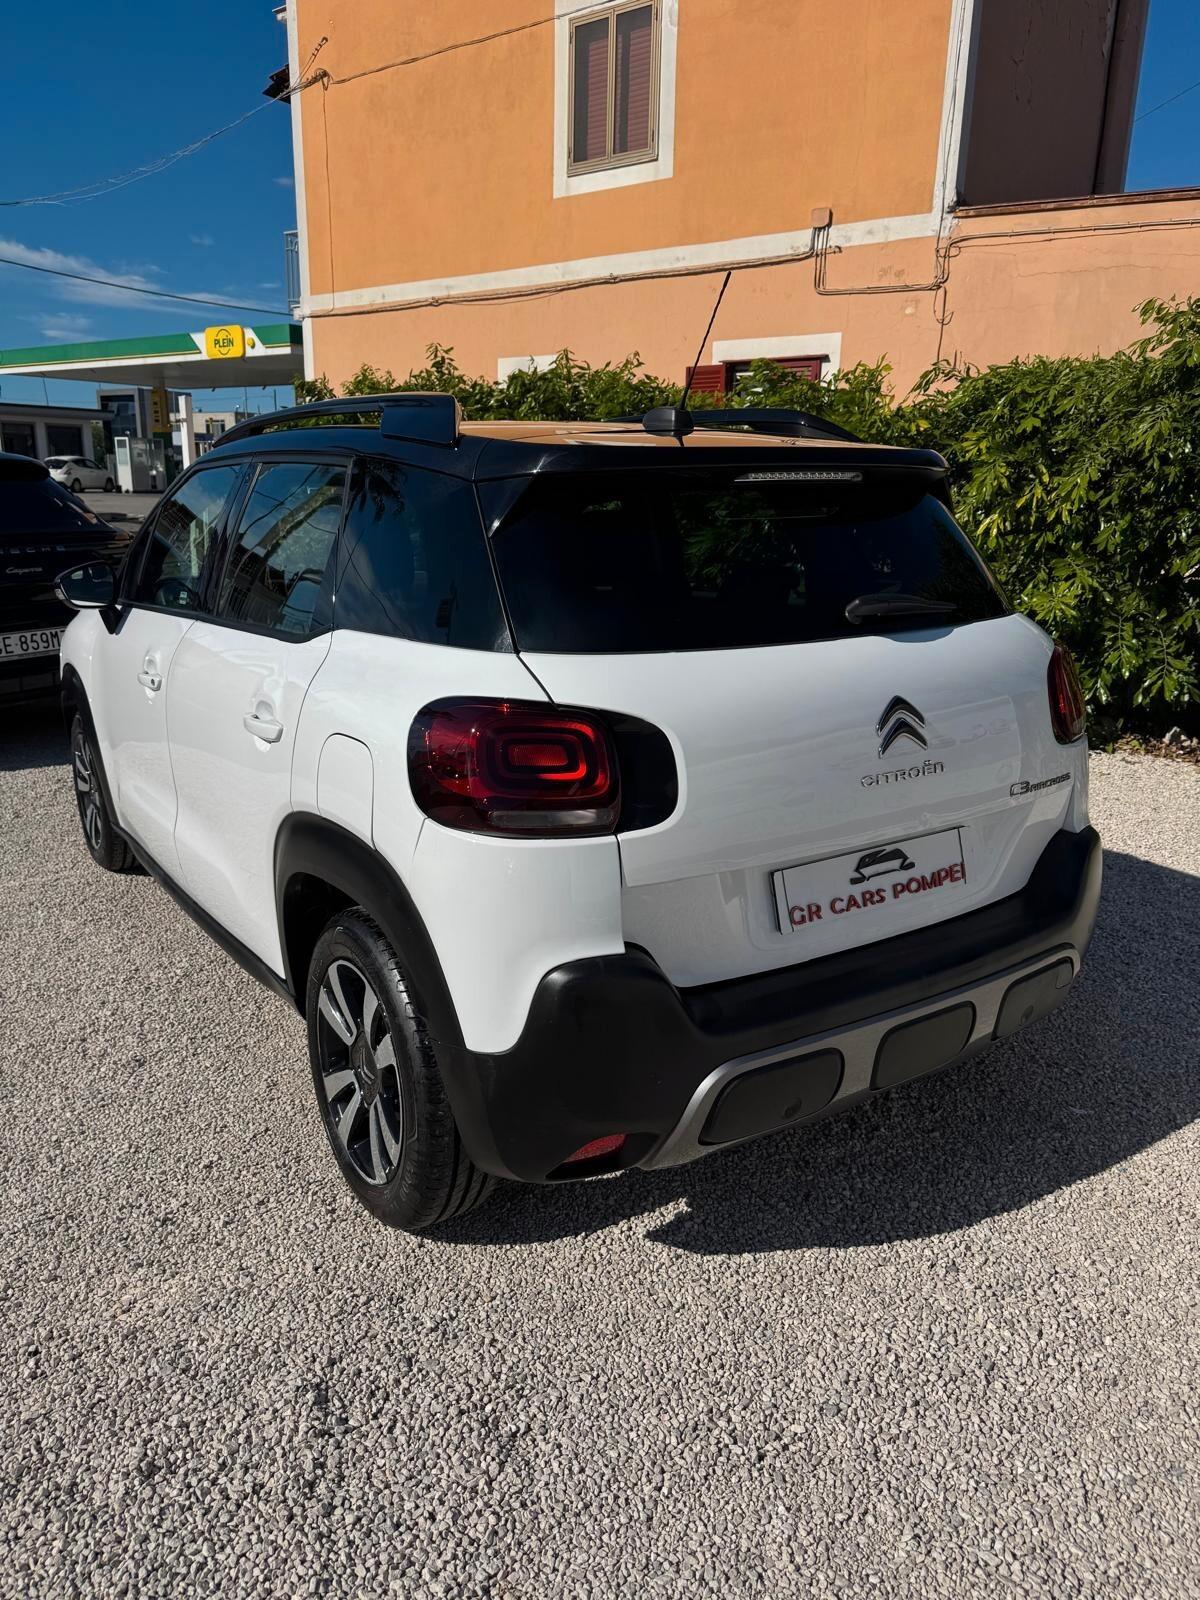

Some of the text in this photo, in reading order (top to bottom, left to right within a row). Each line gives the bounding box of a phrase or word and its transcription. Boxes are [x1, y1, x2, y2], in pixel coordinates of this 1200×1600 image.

[19, 630, 66, 652] 859M
[789, 861, 966, 926] GR CARS POMPEI
